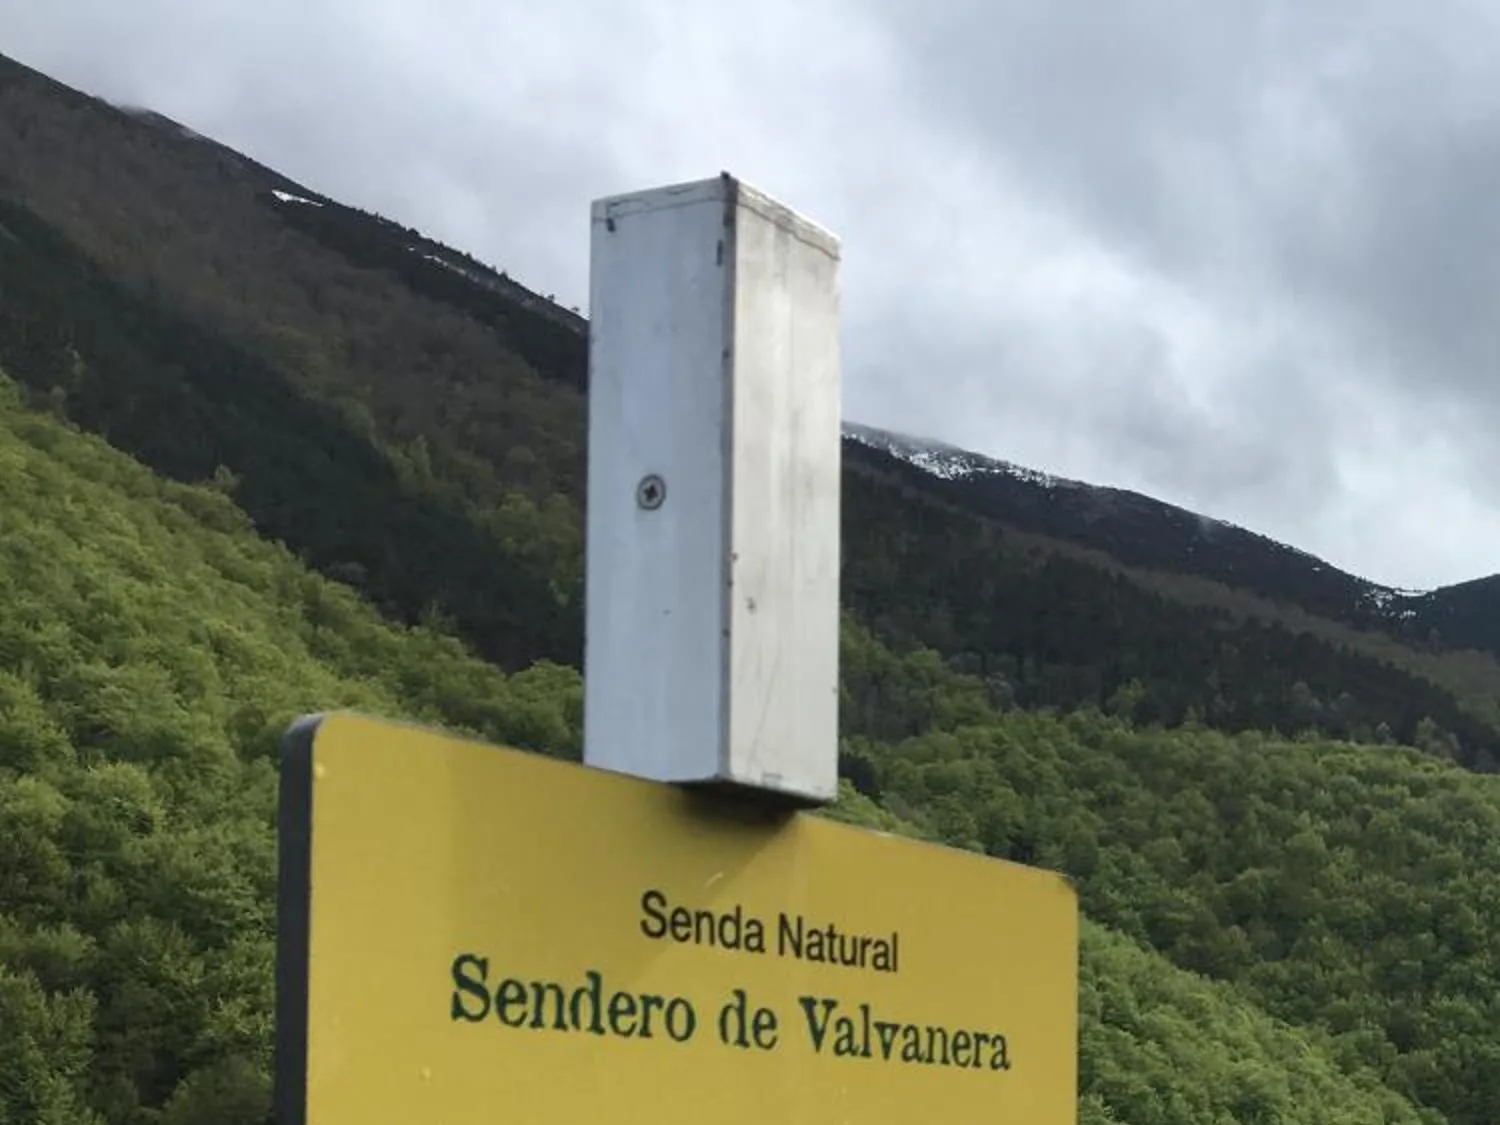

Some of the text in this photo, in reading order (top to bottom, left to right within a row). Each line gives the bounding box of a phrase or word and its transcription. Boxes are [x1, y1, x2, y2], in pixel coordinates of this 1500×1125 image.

[641, 889, 899, 973] Senda Natural
[450, 953, 1012, 1070] Sendero de Valvanera
